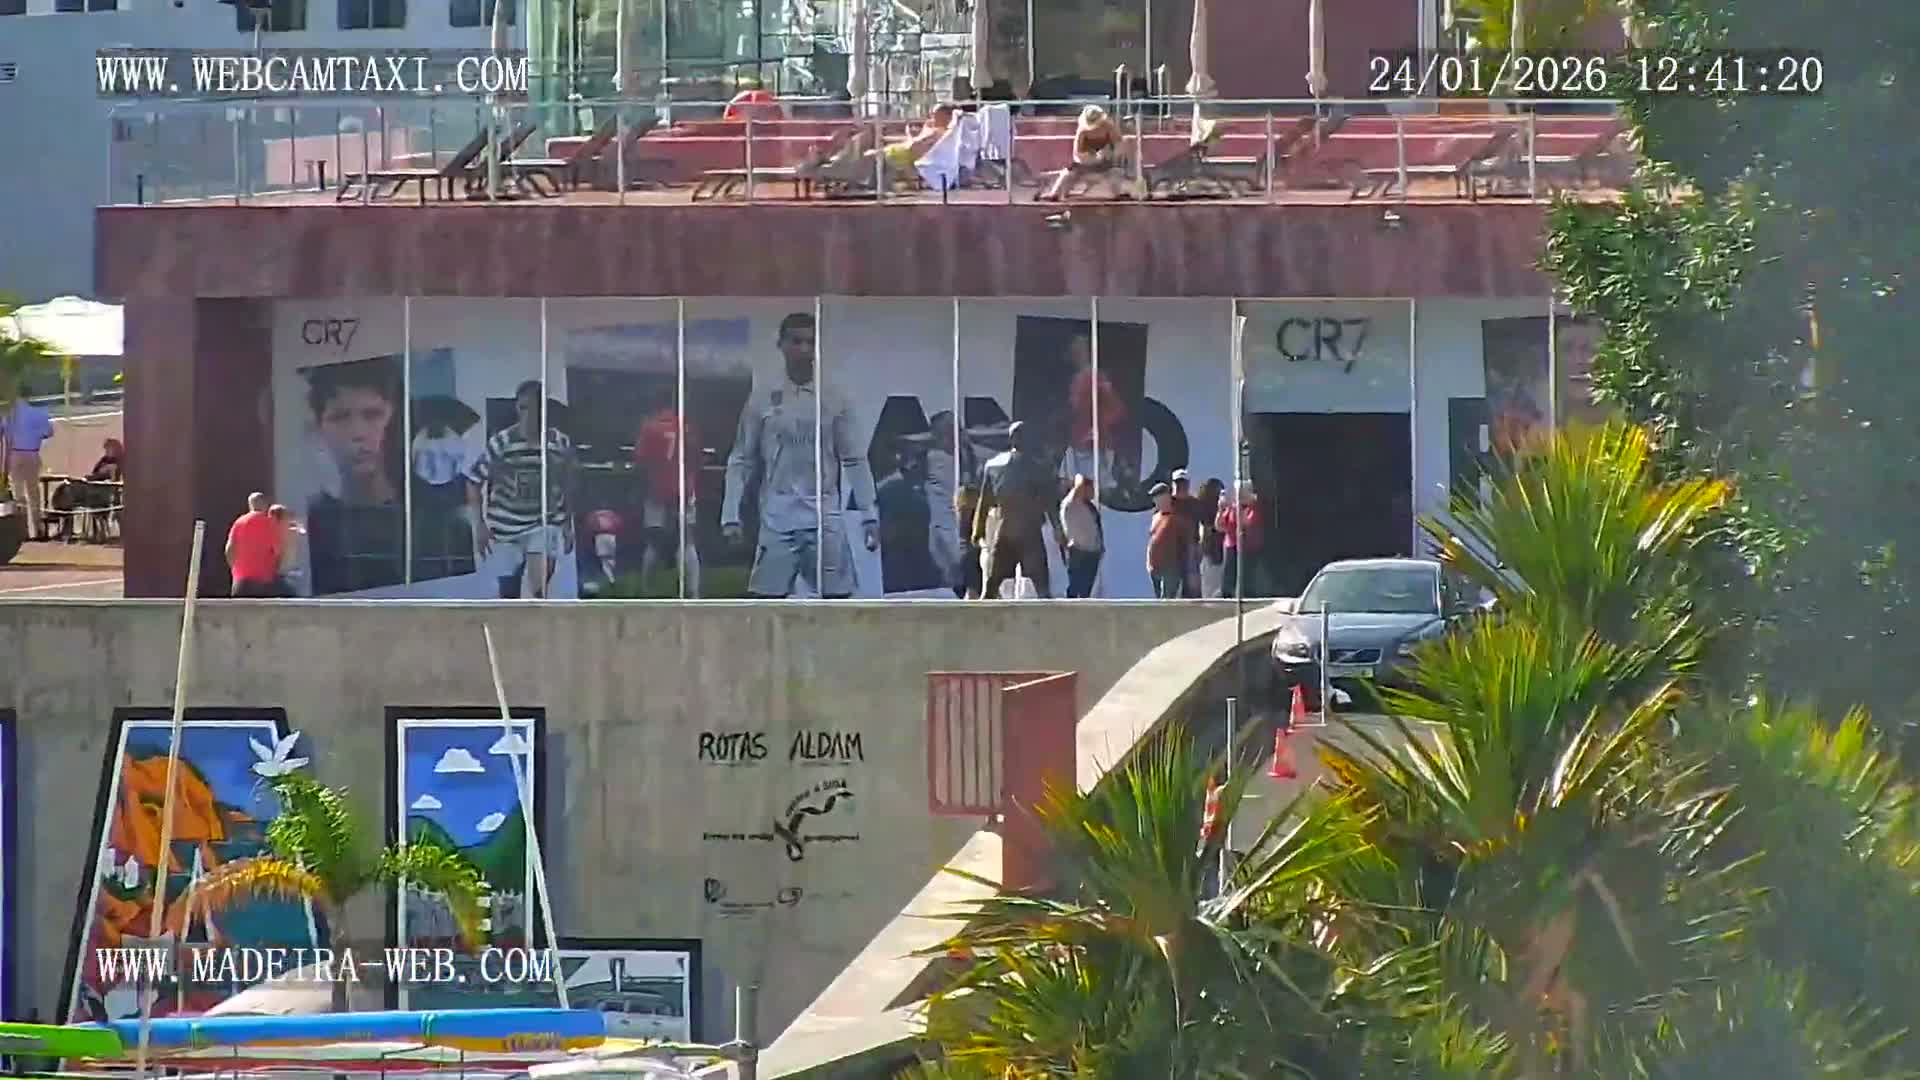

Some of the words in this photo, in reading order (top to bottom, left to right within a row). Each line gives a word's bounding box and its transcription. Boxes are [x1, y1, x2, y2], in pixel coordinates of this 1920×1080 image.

[302, 318, 359, 352] CR7
[1276, 317, 1370, 374] CR7
[698, 731, 768, 760] ROTAS
